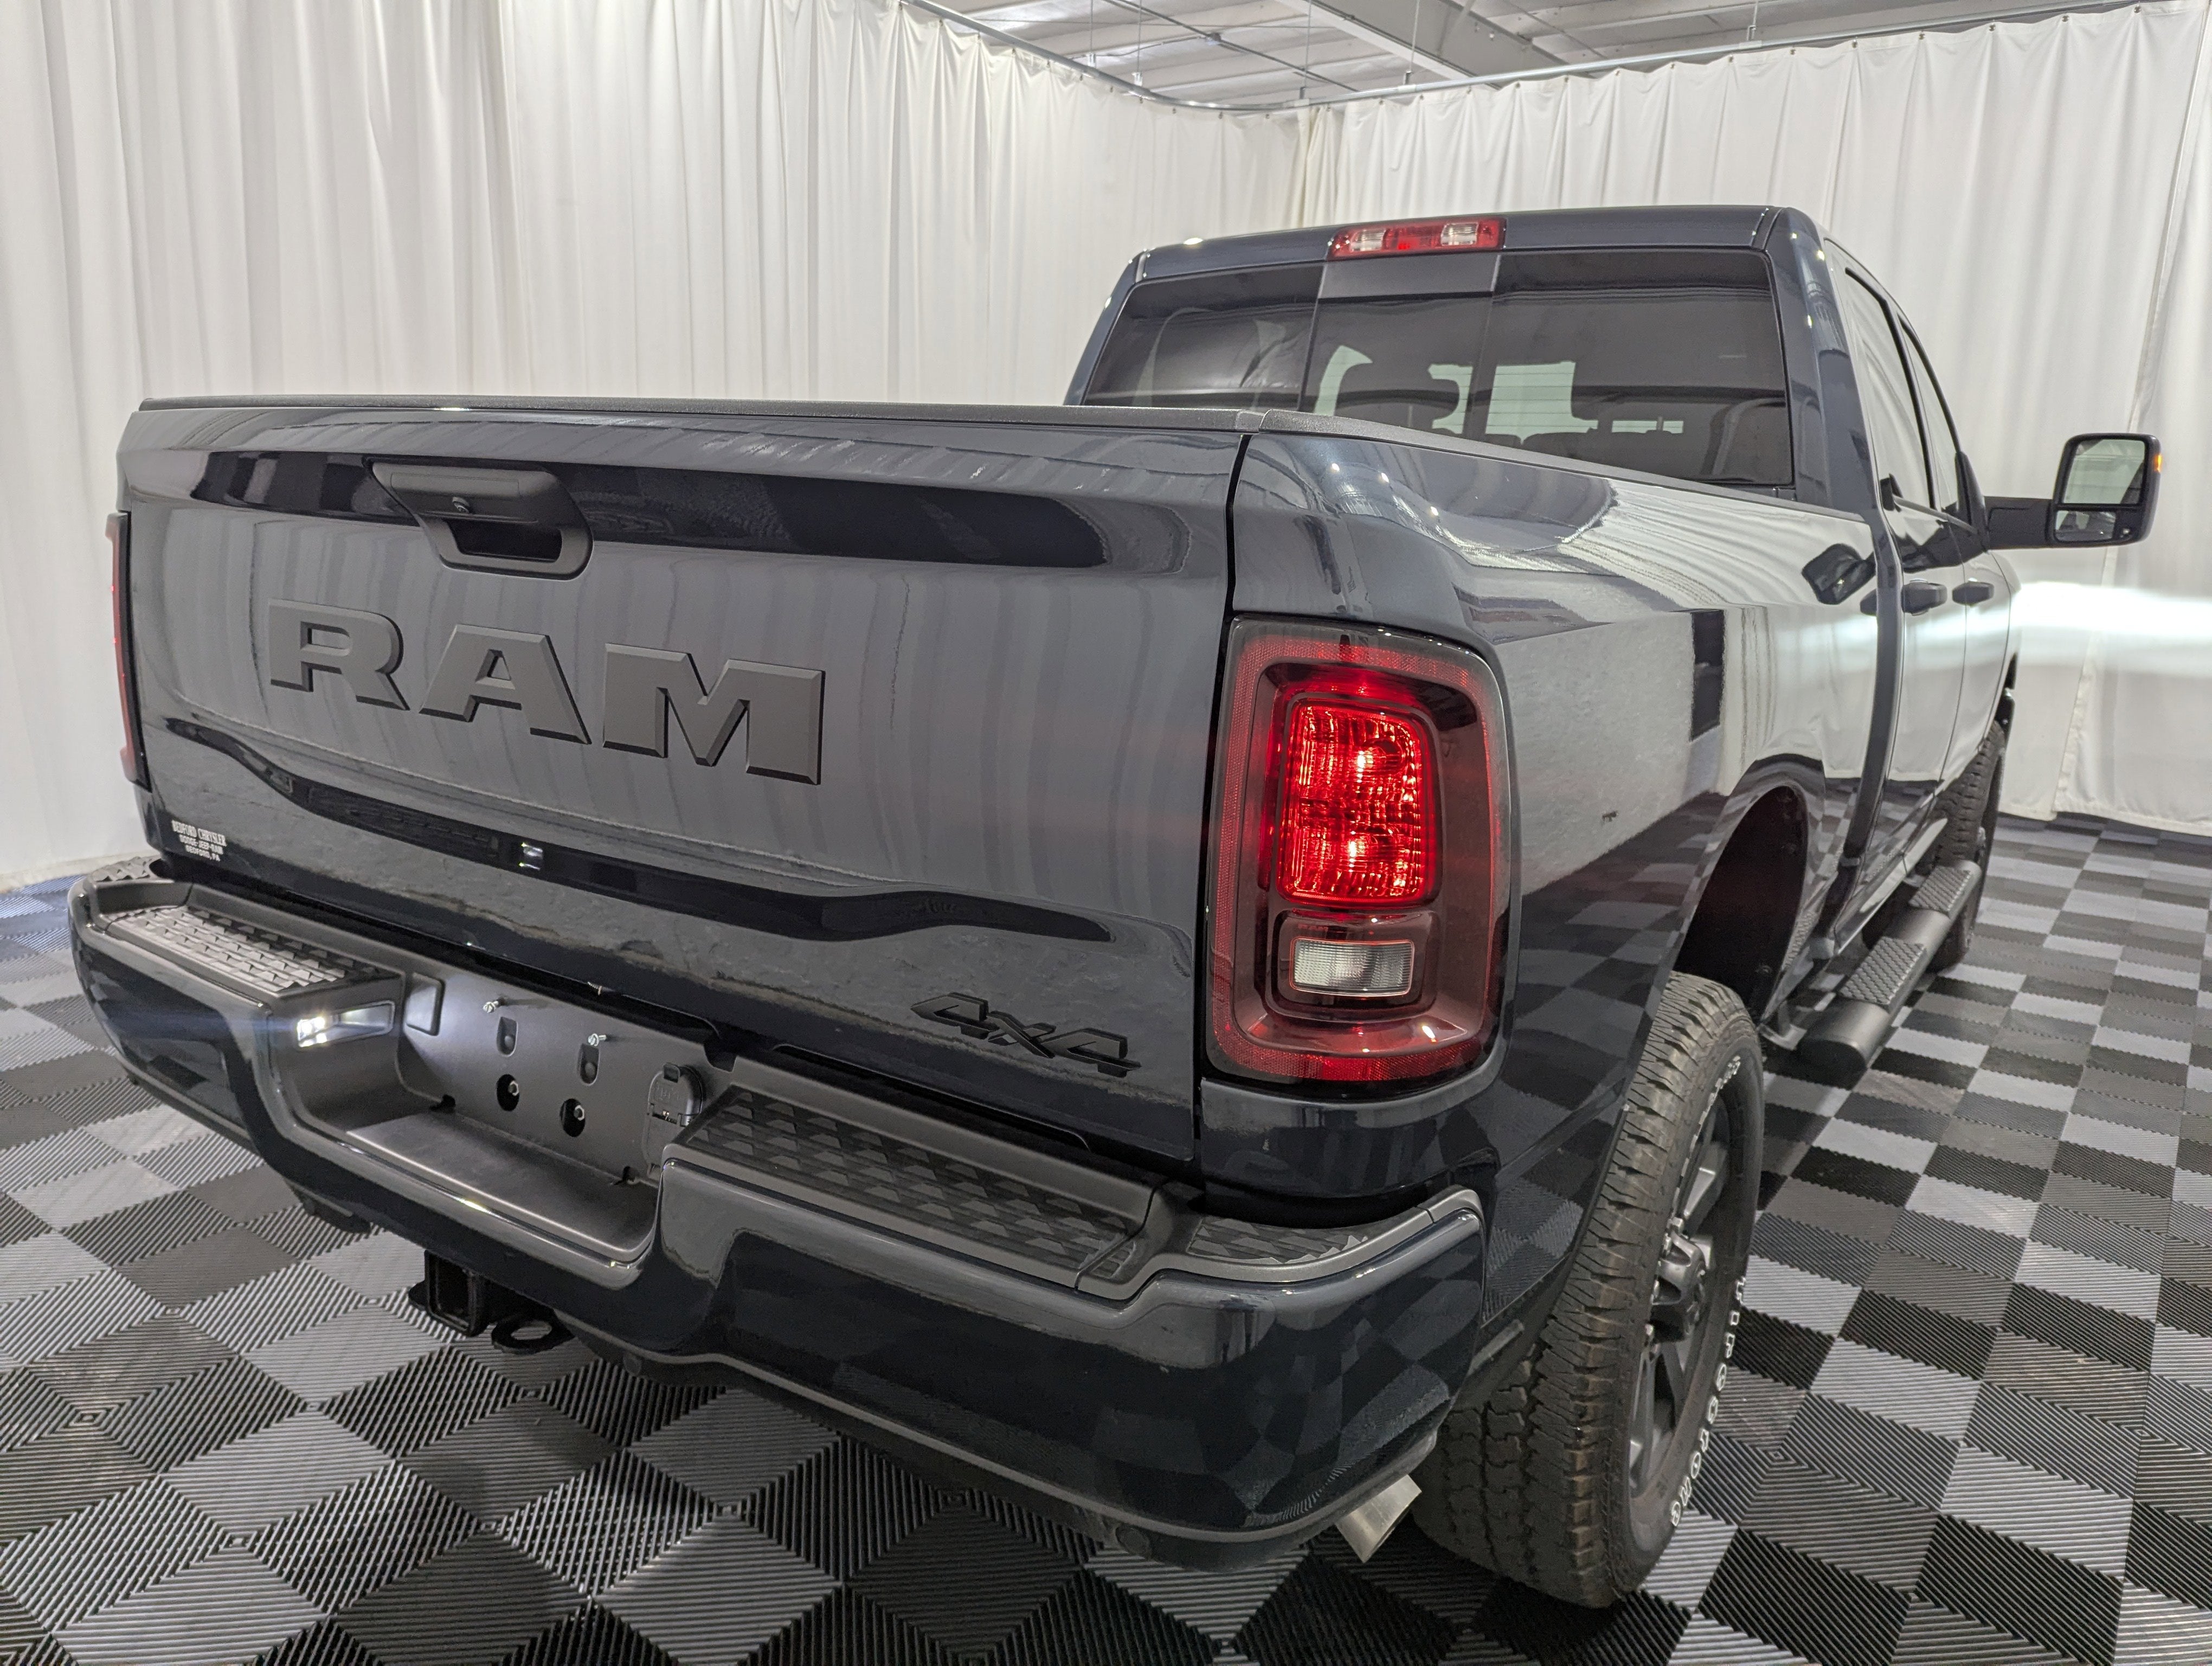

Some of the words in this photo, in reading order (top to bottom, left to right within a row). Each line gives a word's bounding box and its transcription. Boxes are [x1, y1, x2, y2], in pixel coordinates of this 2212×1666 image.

[268, 599, 825, 785] RAM
[171, 819, 197, 838] BEDFORD
[197, 828, 228, 847] CHRYSLER
